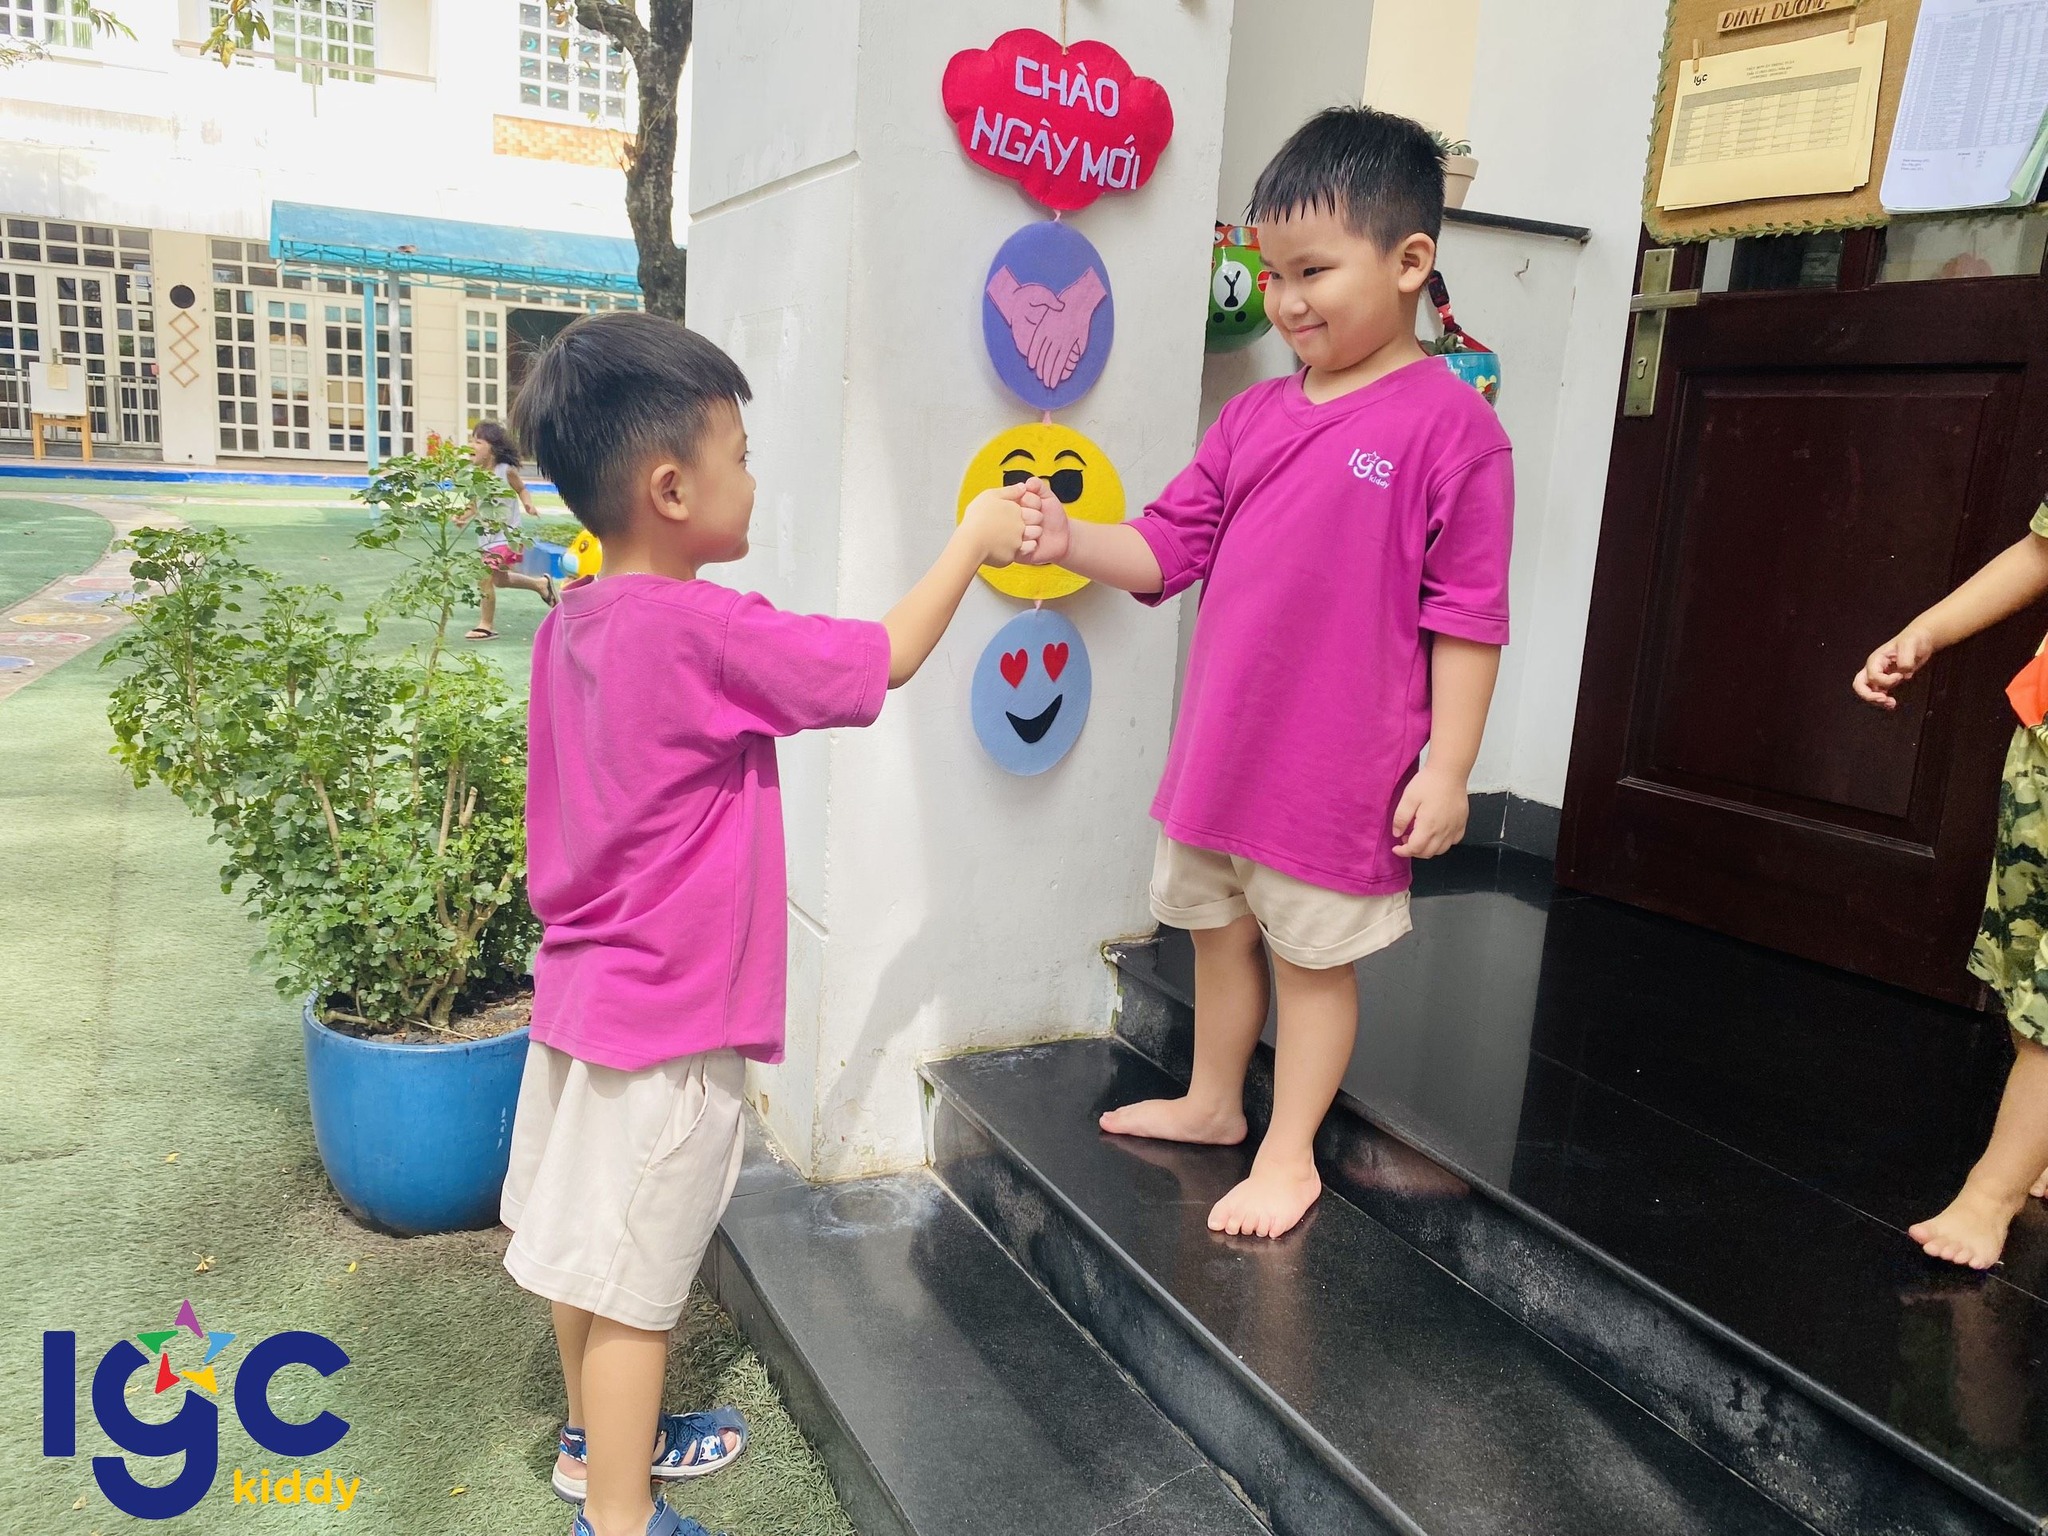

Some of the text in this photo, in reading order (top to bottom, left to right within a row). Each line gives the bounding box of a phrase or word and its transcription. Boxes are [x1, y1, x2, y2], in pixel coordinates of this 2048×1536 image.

[1722, 7, 1766, 28] DINH
[1015, 56, 1119, 117] CHÀO
[970, 106, 1140, 190] NGÀY MỚI
[1368, 474, 1390, 490] kiddy
